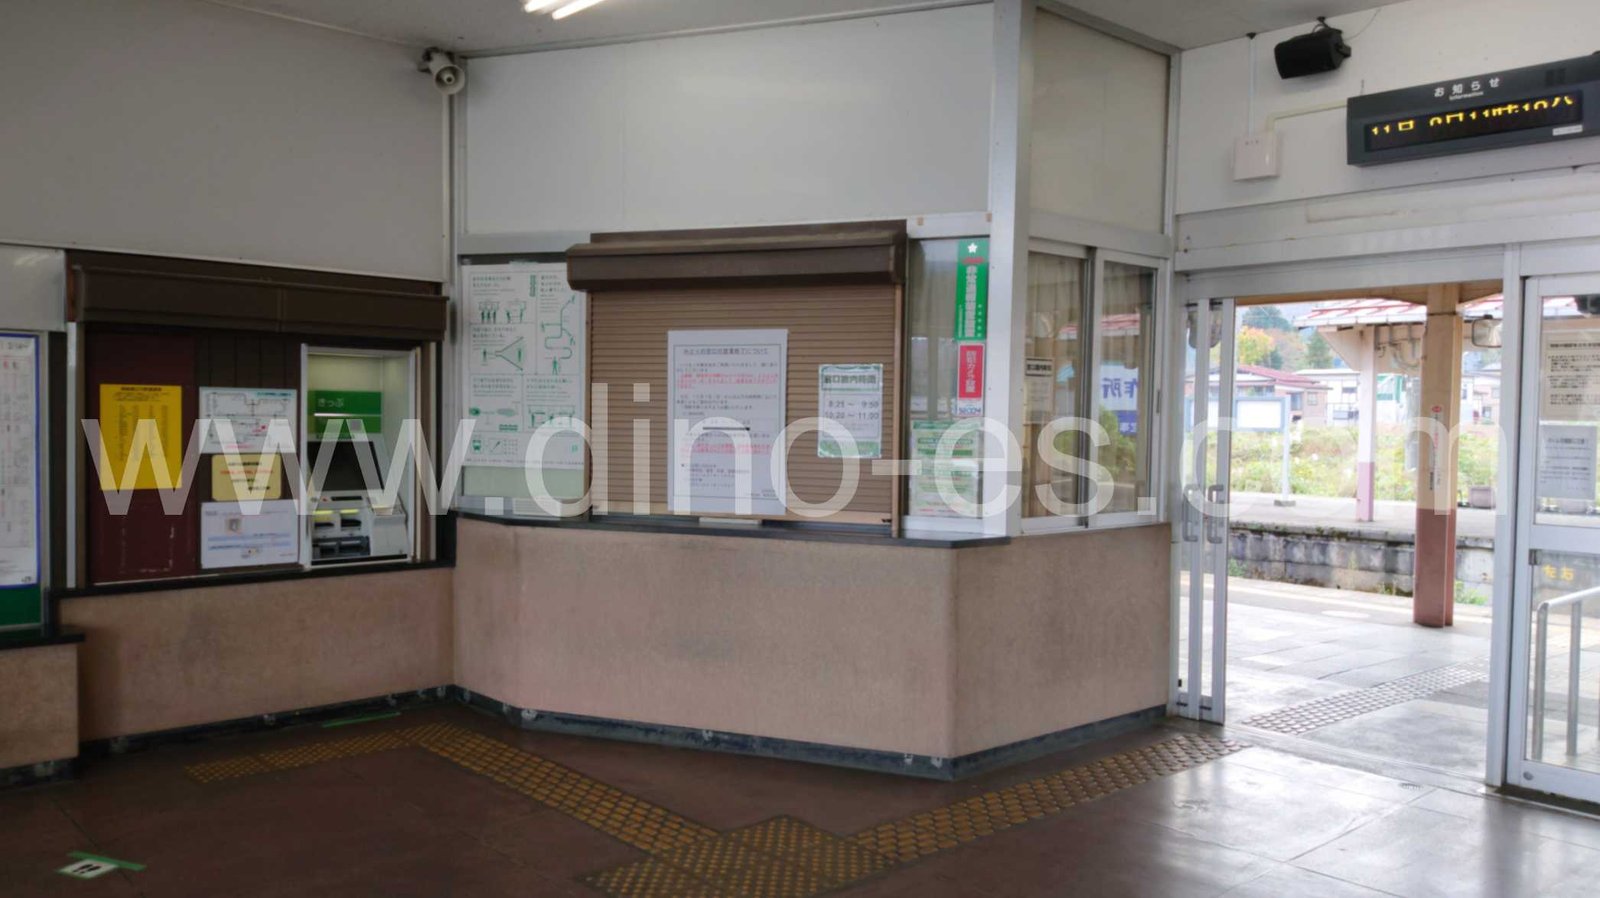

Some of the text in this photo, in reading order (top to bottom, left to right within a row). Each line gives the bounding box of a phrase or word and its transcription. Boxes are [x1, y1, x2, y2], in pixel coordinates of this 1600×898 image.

[1433, 77, 1500, 98] お知らせ
[318, 397, 345, 408] きっぷ
